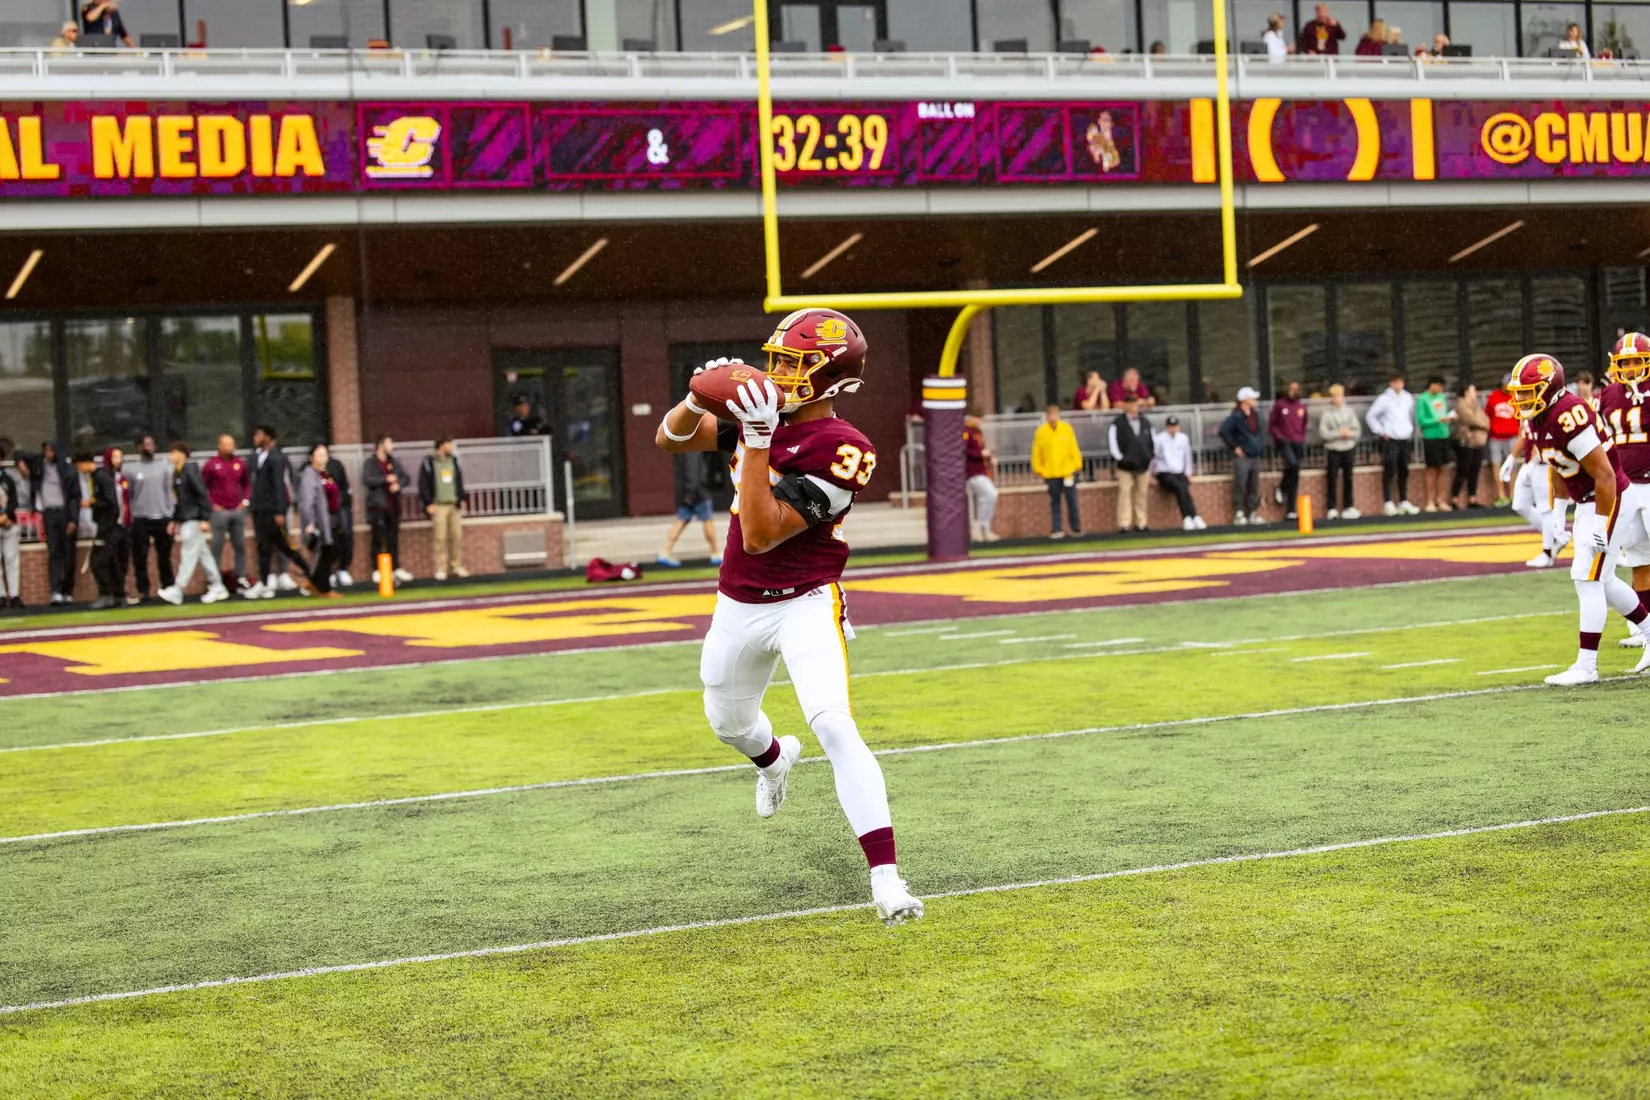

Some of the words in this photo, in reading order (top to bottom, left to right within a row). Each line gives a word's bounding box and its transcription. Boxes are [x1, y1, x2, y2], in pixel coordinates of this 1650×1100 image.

[91, 114, 326, 179] MEDIA
[646, 129, 669, 164] &
[769, 114, 888, 172] 32:39
[1481, 112, 1650, 164] @CMU
[1557, 404, 1589, 433] 30
[1610, 407, 1648, 445] 11
[830, 444, 877, 486] 33
